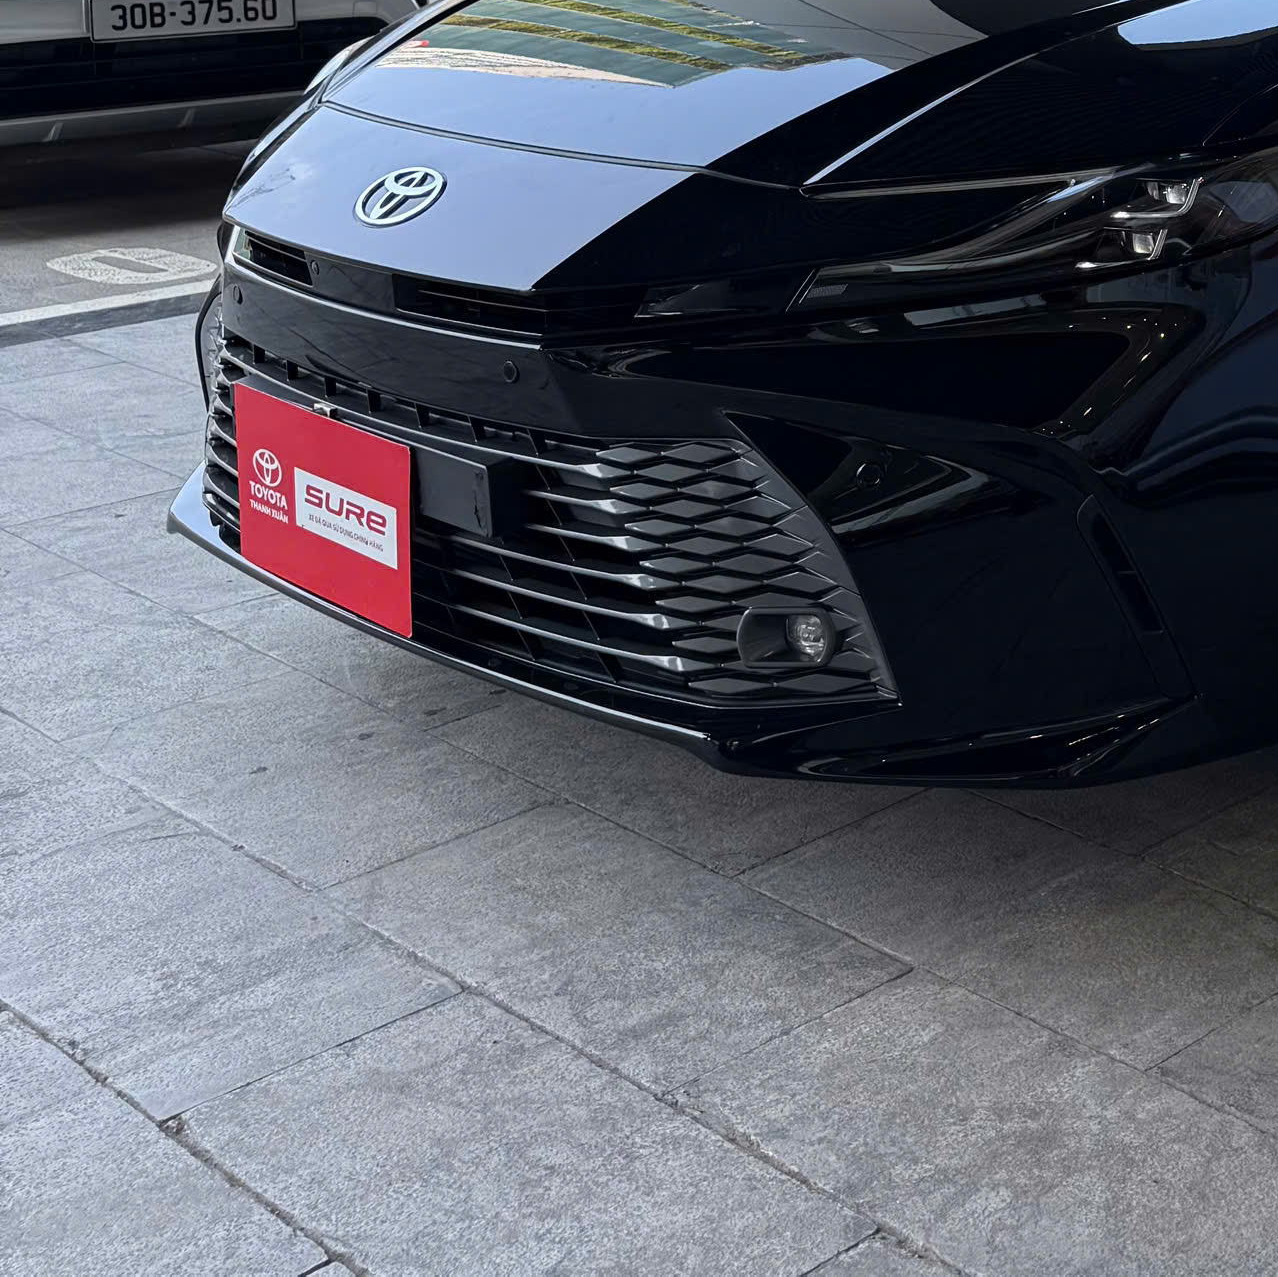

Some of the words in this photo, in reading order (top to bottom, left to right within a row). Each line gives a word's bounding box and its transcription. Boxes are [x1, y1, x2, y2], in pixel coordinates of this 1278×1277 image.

[249, 480, 288, 510] TOYOTA
[249, 499, 271, 517] THANH
[271, 506, 289, 524] XUÂN
